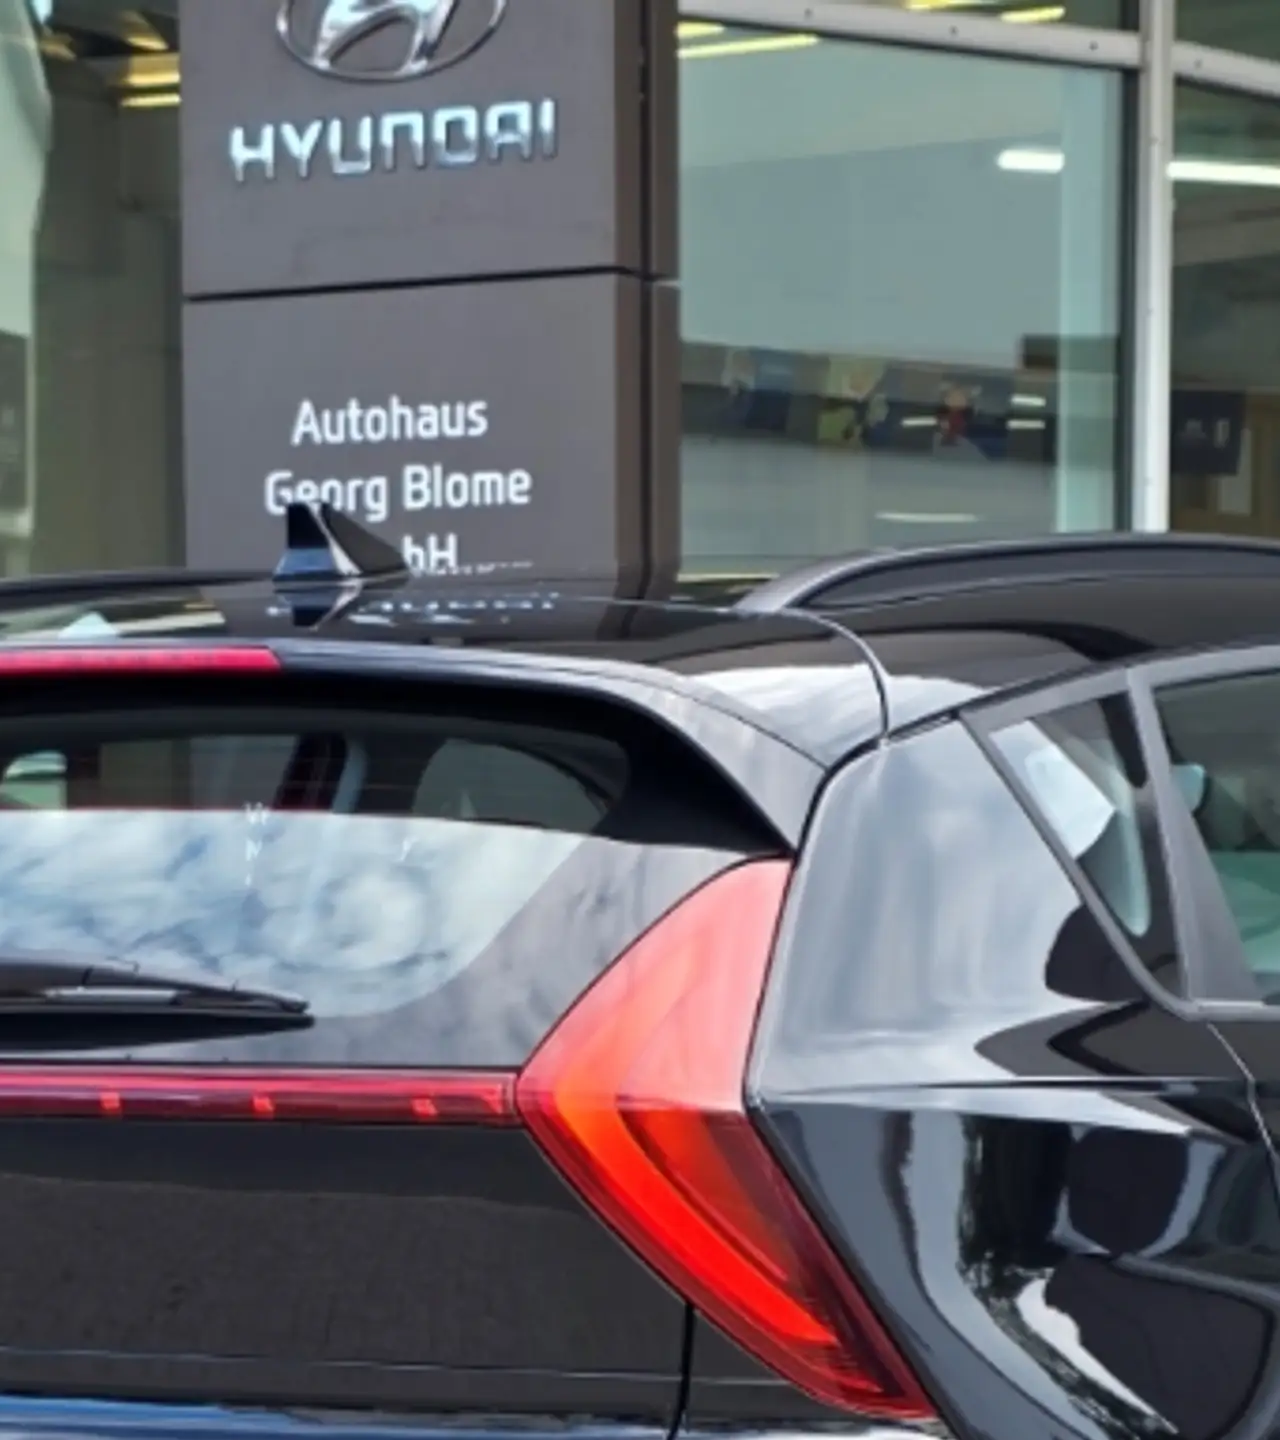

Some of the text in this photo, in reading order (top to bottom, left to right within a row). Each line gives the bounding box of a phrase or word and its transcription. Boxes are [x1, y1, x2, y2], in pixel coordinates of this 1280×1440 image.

[230, 97, 555, 183] HYUNDAI
[290, 393, 489, 447] Autohaus
[264, 462, 532, 523] Georg Blome
[402, 532, 458, 574] bH
